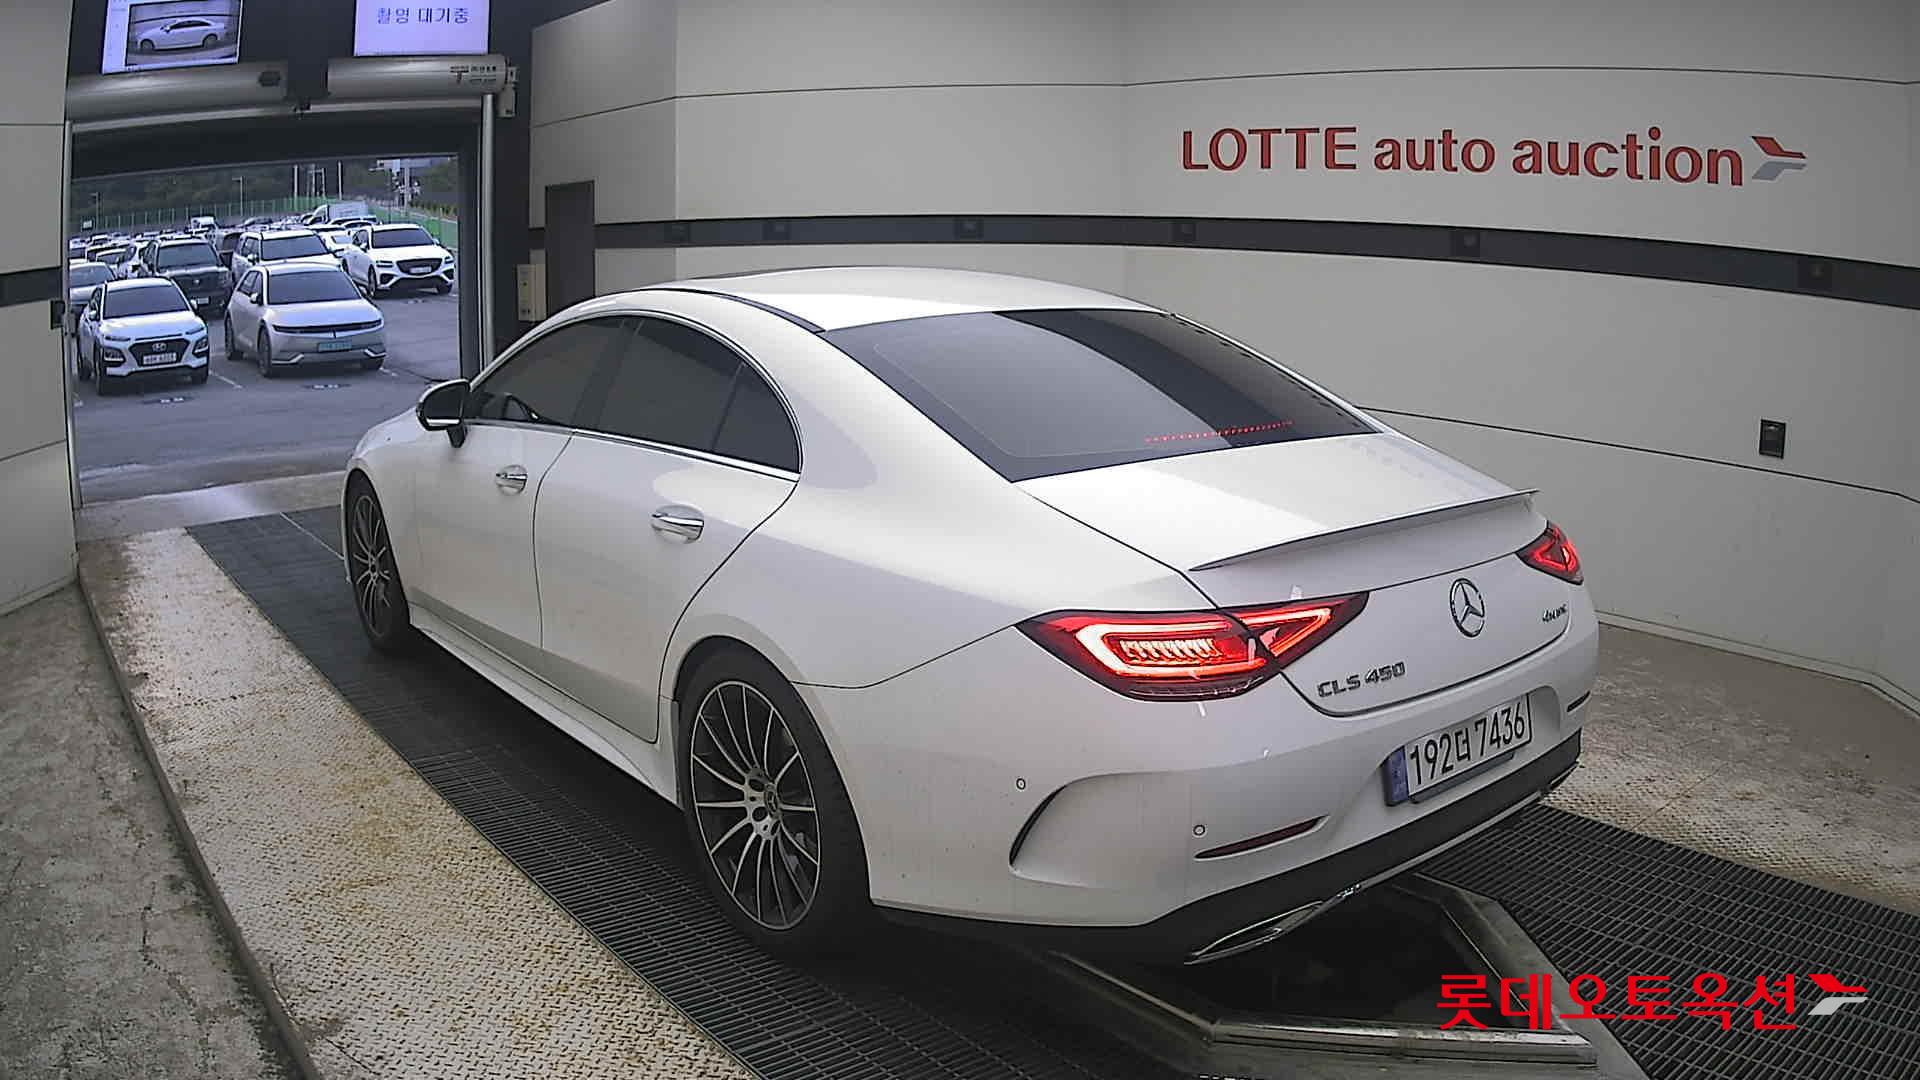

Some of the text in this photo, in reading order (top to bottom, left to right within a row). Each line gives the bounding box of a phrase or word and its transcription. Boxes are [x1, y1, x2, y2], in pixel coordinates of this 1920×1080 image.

[418, 7, 468, 24] 대기중
[1181, 126, 1744, 187] LOTTE auto auction
[1317, 661, 1406, 698] CLS 450
[1410, 702, 1525, 785] 192더 7436
